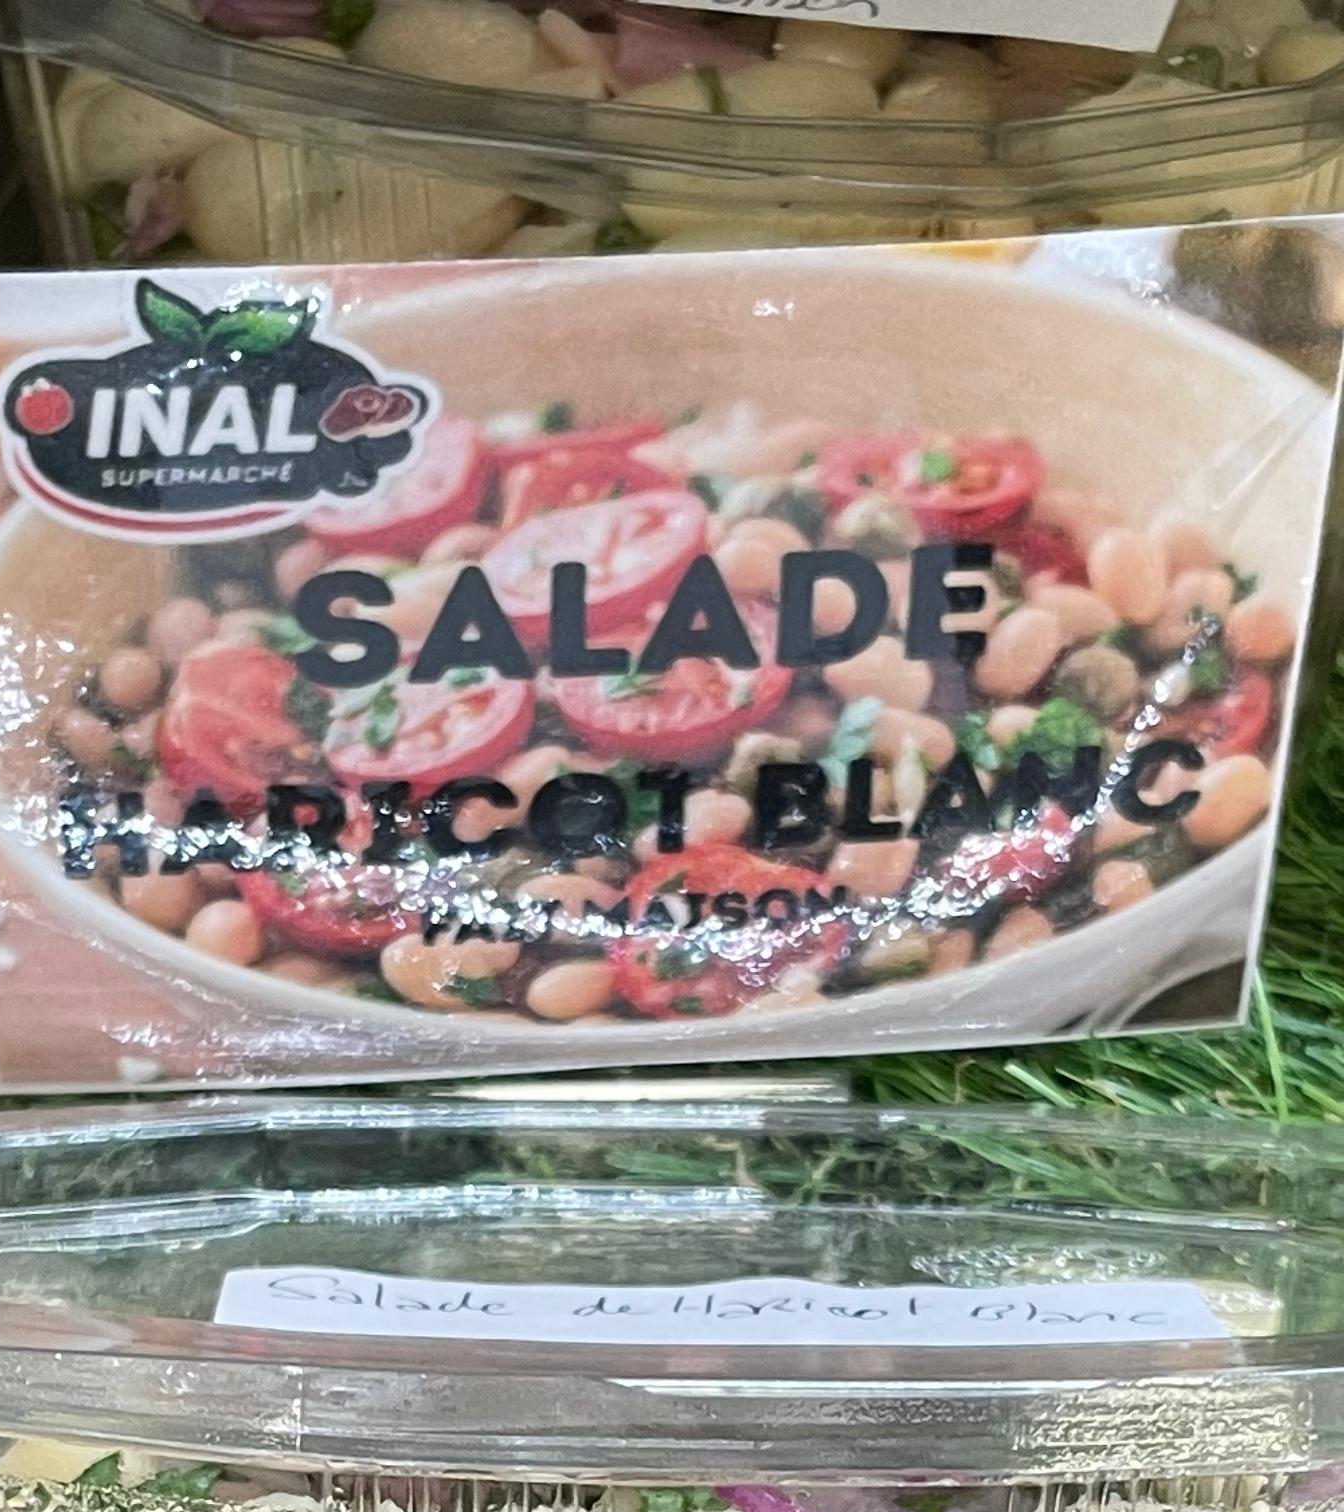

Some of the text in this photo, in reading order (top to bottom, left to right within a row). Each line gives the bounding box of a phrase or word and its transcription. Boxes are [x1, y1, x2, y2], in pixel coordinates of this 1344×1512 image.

[85, 383, 319, 459] INAL
[293, 542, 995, 689] SALADE
[756, 740, 1206, 850] BLANC
[268, 1274, 516, 1318] Salade
[573, 1296, 650, 1318] de
